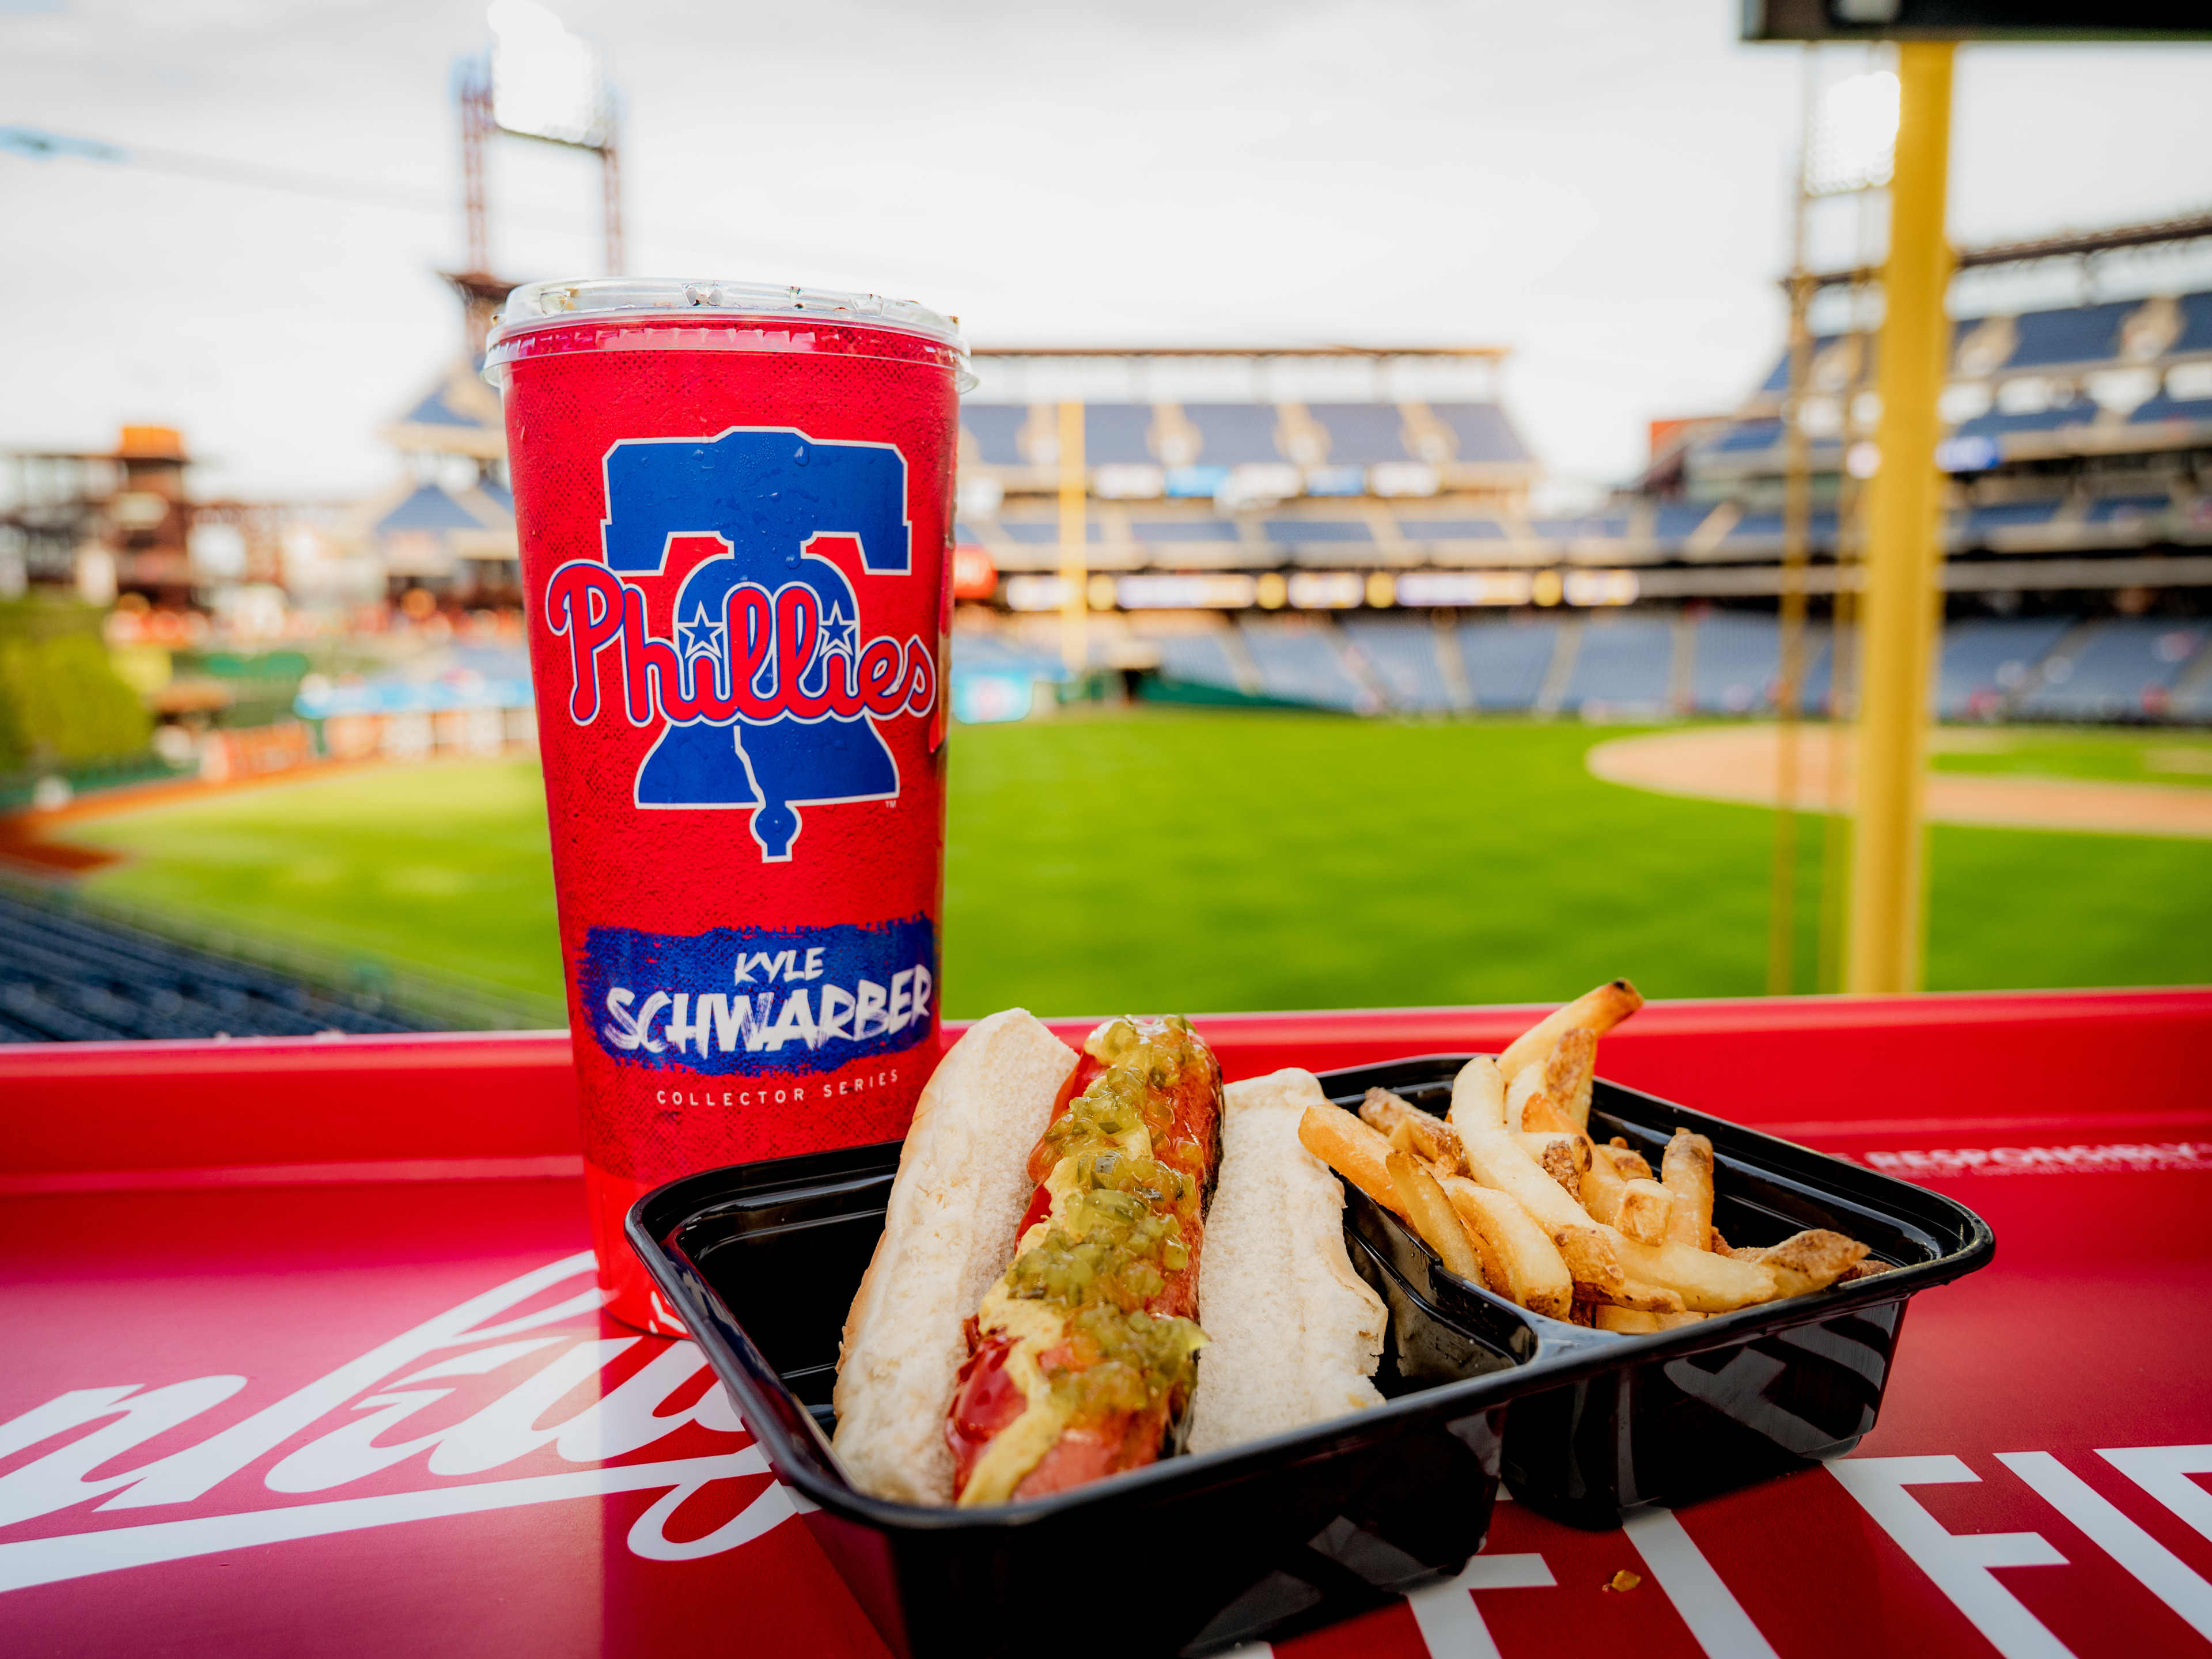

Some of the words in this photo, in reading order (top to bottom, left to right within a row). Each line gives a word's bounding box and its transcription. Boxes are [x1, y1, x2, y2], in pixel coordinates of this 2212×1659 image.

[546, 559, 937, 726] Phillies
[885, 800, 896, 808] TM
[734, 946, 826, 986] KYLE
[604, 963, 932, 1060] SCHWARBER
[656, 1087, 805, 1106] COLLECTOR
[823, 1069, 899, 1098] SERIES
